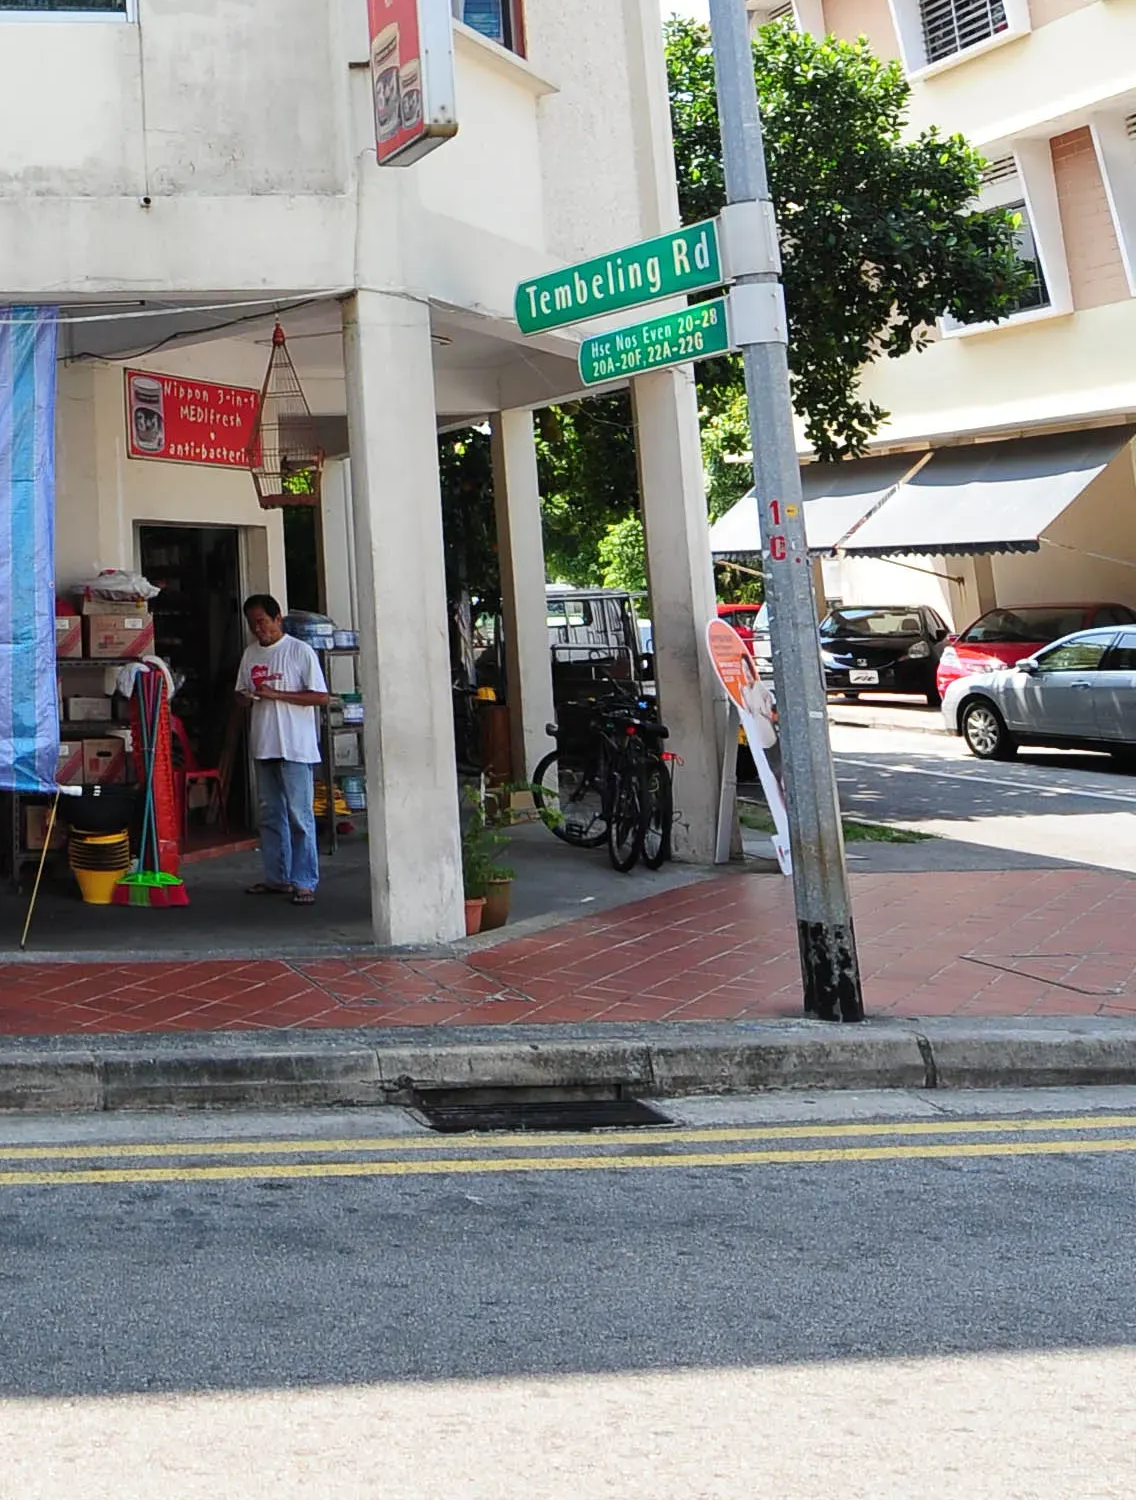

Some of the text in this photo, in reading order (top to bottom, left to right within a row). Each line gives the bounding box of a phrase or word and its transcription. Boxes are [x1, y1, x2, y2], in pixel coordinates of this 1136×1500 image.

[525, 231, 709, 318] Tembeling Rd
[591, 307, 718, 359] Hse Nos Even 20-28
[592, 331, 704, 377] 20A-20F, 22A-22G
[164, 380, 209, 403] Nippon
[218, 389, 255, 410] 3-in-1
[179, 405, 242, 427] MEDIfresh
